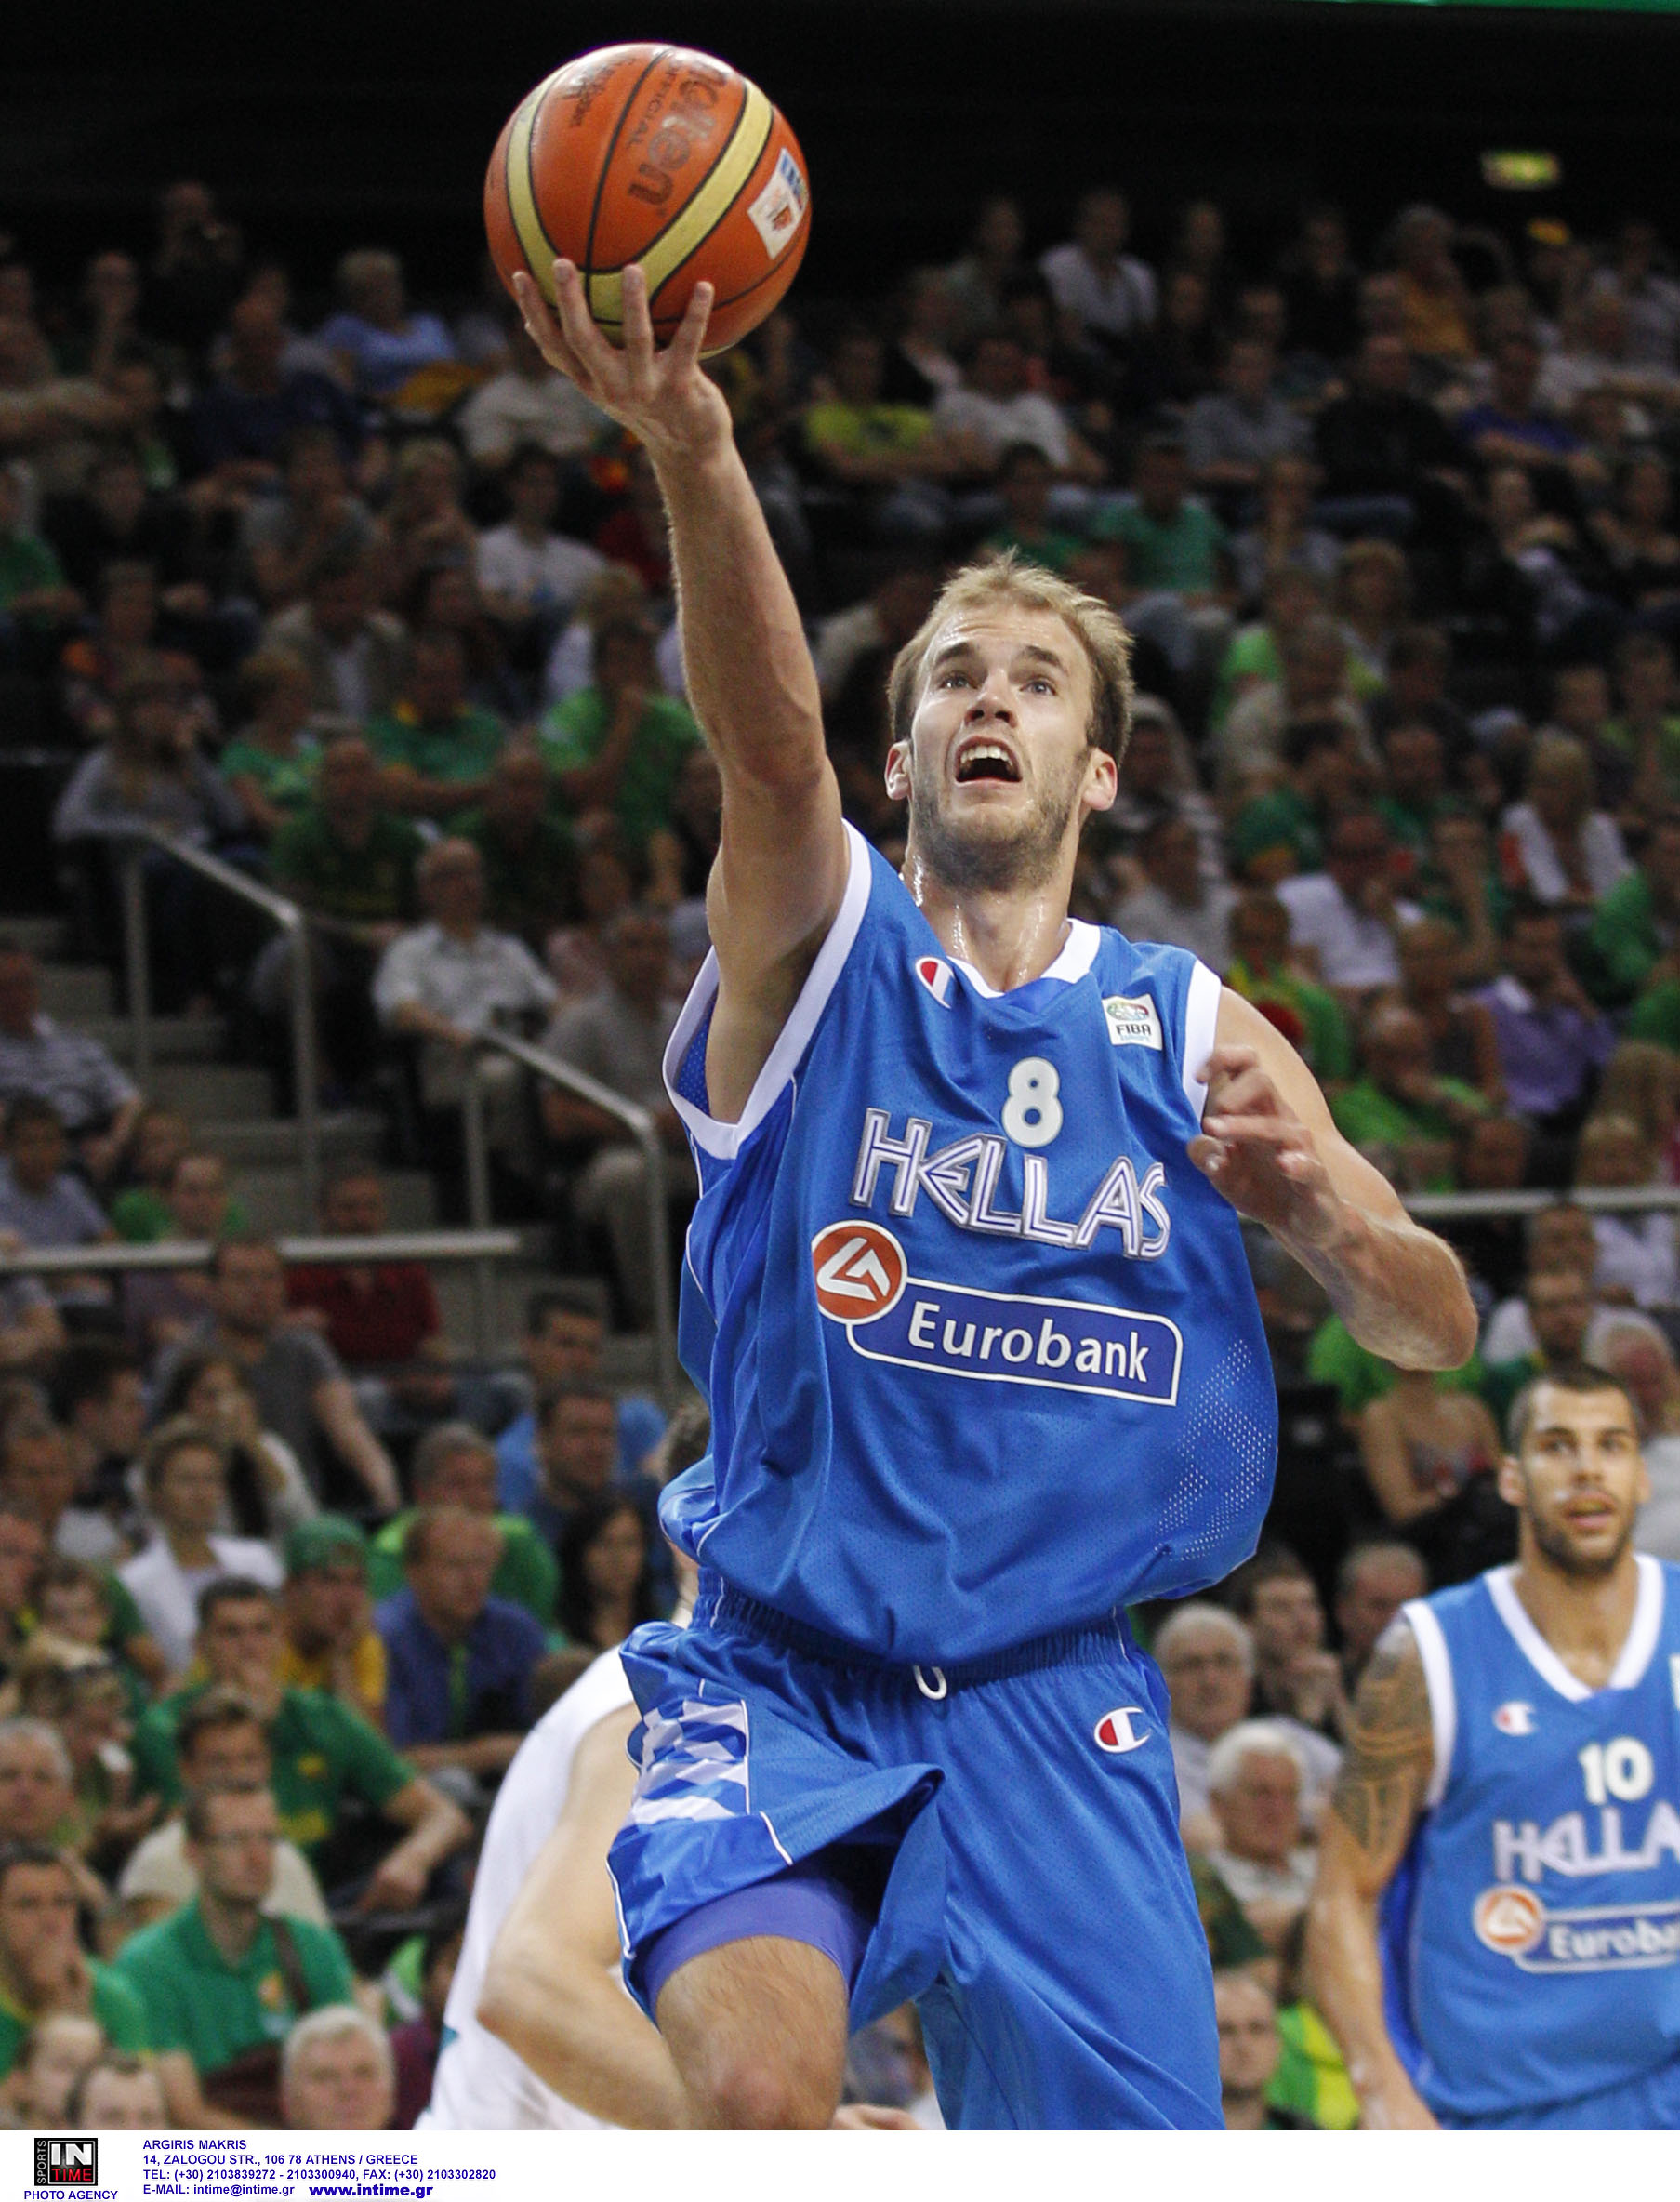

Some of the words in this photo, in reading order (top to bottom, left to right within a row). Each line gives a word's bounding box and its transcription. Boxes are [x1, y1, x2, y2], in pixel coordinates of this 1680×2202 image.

[1116, 1024, 1152, 1036] FIBA
[1001, 1056, 1064, 1148] 8
[849, 1108, 1171, 1261] HELLAS
[907, 1300, 1149, 1383] Eurobank
[1579, 1736, 1655, 1805] 10
